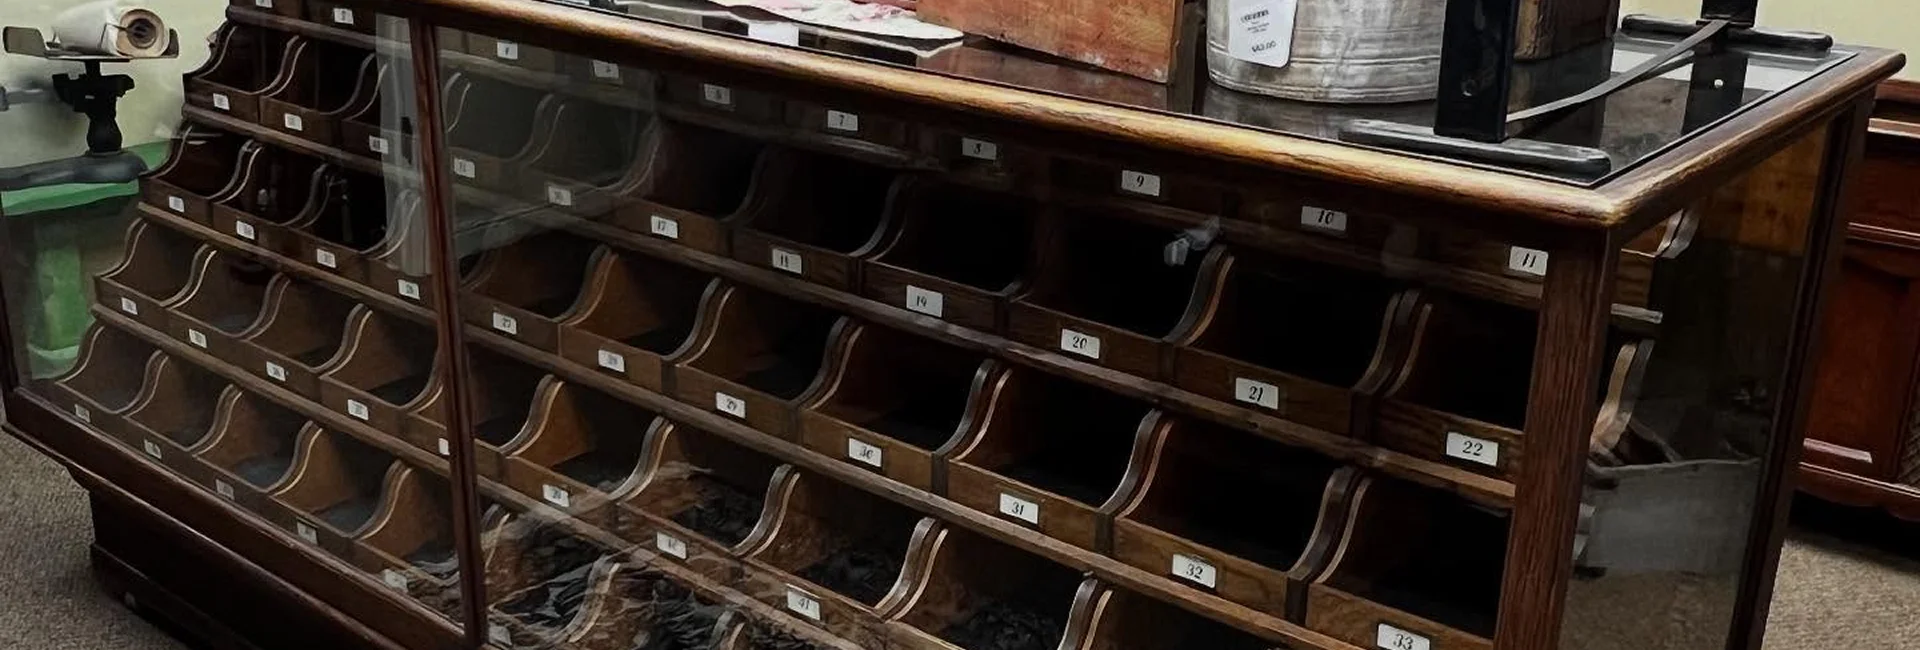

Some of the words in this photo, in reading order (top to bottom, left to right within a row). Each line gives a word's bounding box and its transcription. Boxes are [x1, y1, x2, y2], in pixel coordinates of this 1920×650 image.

[1318, 210, 1334, 225] 10
[1522, 253, 1537, 268] 11
[916, 296, 928, 307] 19
[1072, 336, 1088, 349] 20
[1248, 386, 1264, 402] 21
[859, 446, 874, 460] 30
[1462, 440, 1484, 457] 22
[1011, 501, 1025, 516] 31
[1186, 563, 1204, 579] 32
[798, 597, 811, 610] 41
[1393, 633, 1414, 650] 33
